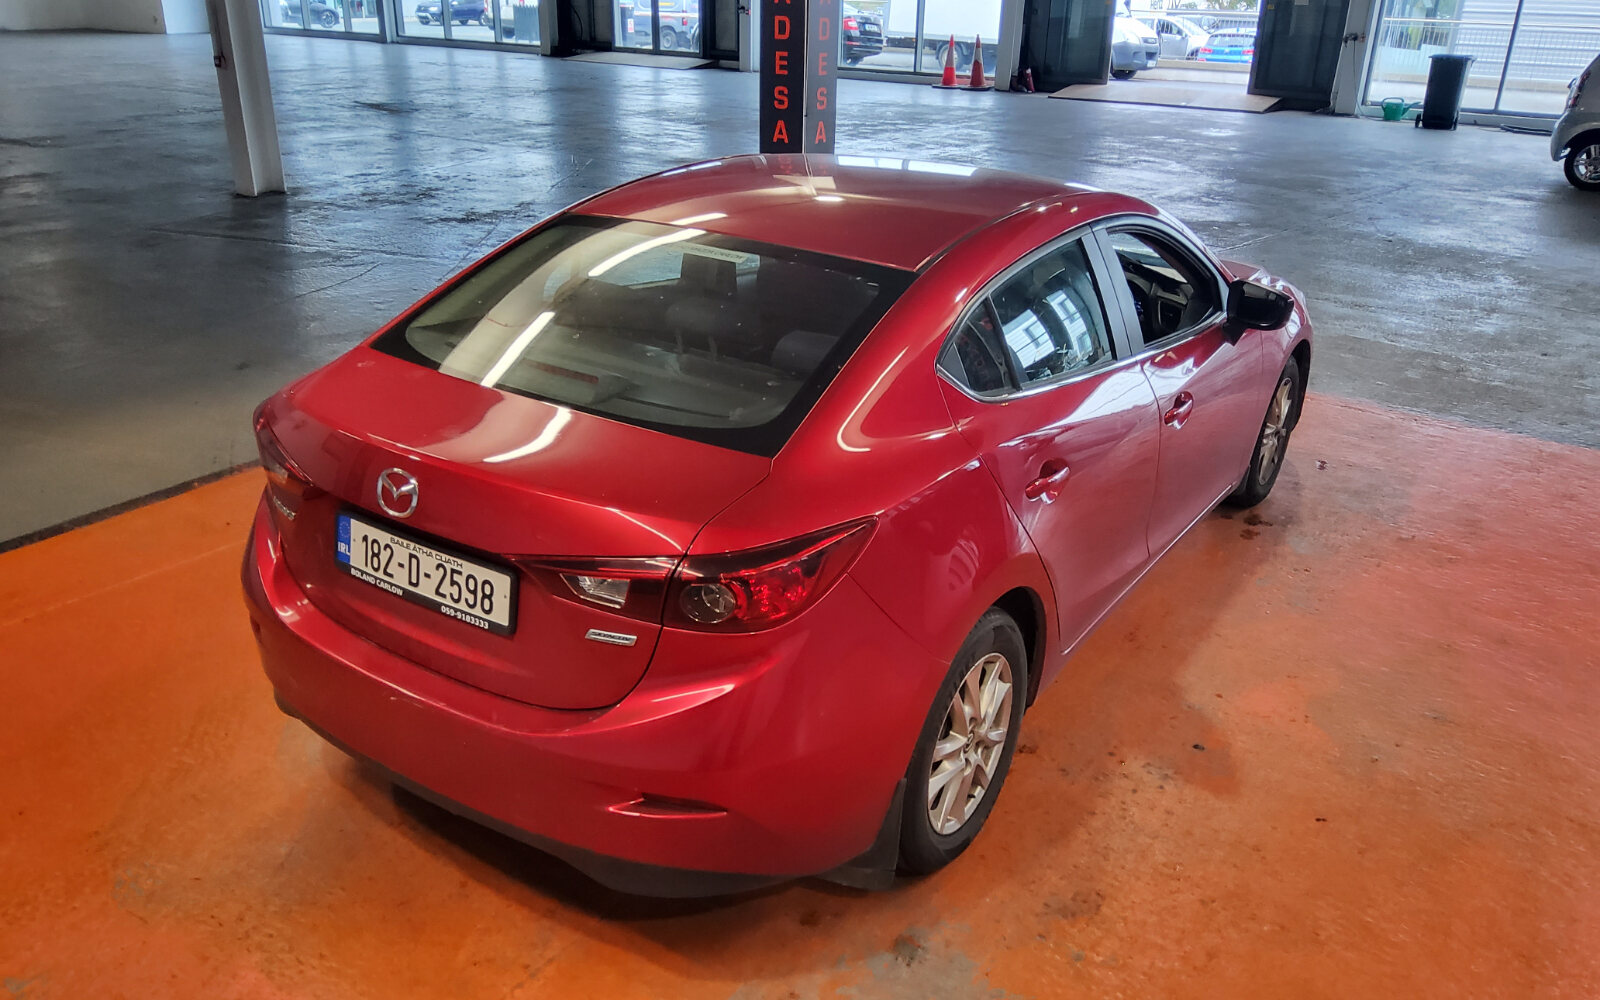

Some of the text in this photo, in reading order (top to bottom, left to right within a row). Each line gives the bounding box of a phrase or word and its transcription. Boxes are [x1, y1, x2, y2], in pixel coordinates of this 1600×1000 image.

[772, 0, 791, 144] DESA
[814, 0, 831, 145] DESA
[337, 541, 351, 556] IRL
[390, 536, 412, 551] BAILE
[350, 567, 404, 597] BOLAND CARLOW
[361, 533, 495, 615] 182-D-2598
[441, 605, 489, 630] 059-9183333
